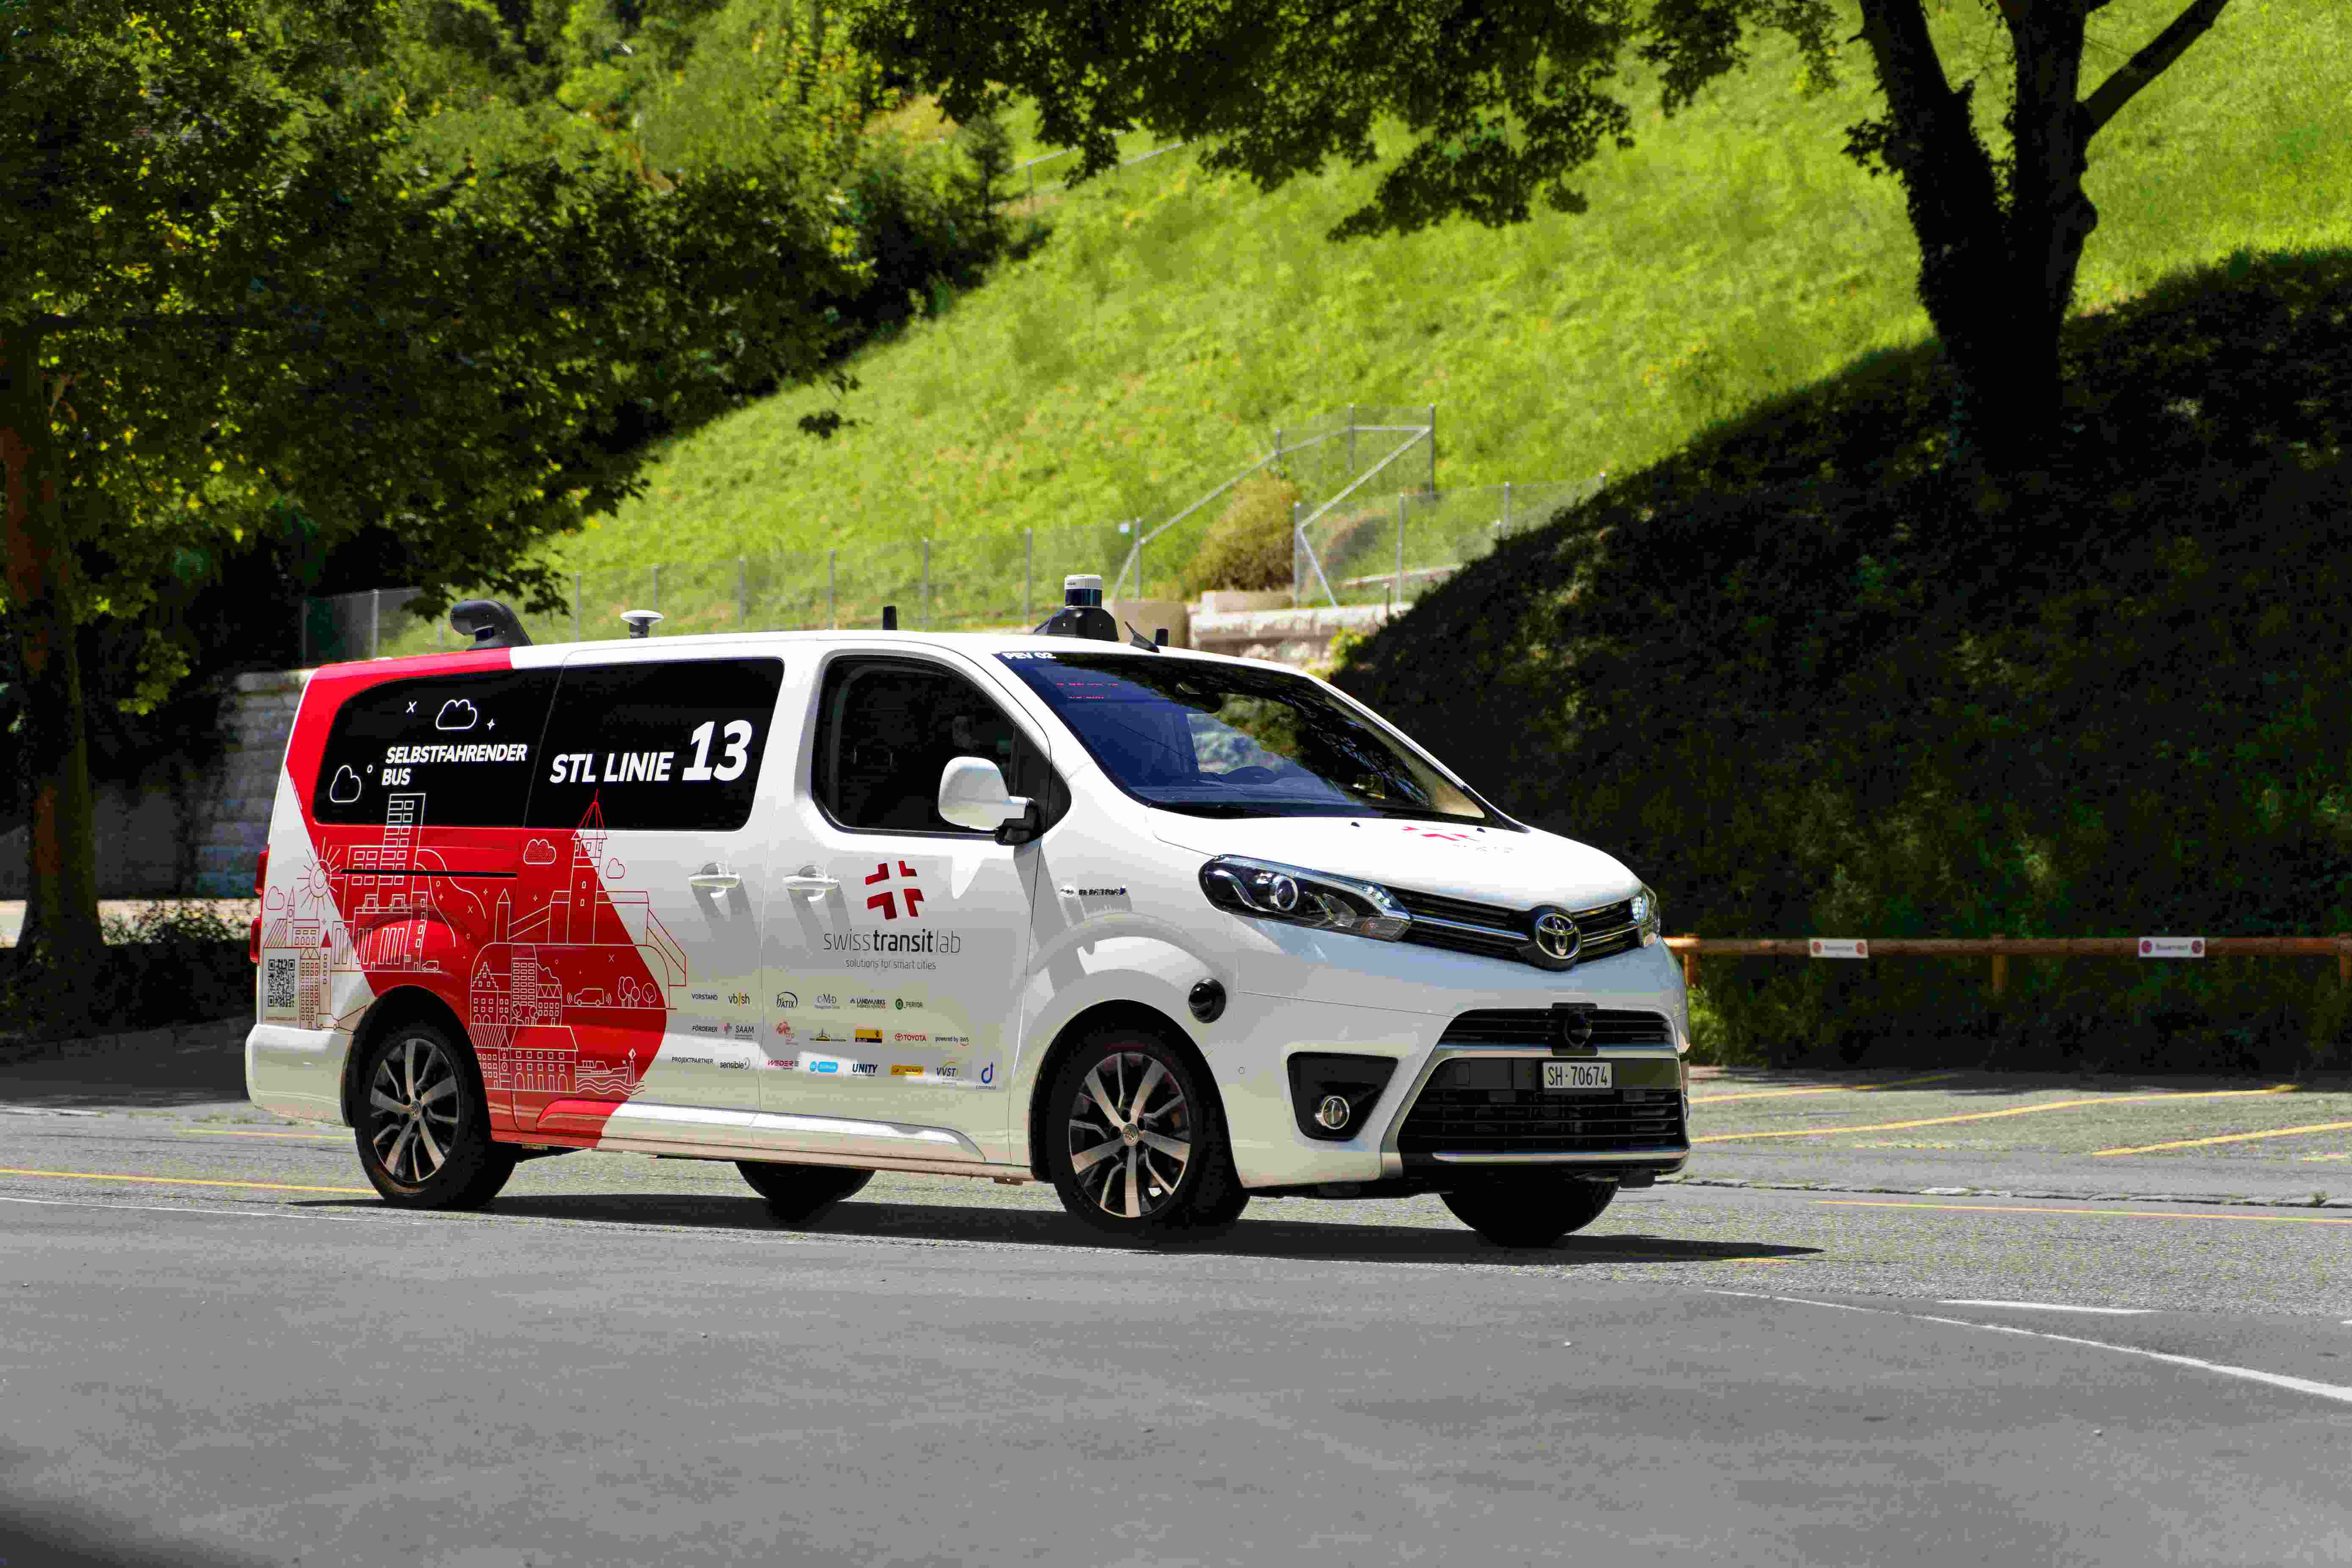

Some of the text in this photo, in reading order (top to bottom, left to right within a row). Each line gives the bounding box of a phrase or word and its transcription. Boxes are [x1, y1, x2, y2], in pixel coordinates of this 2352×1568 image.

[385, 744, 528, 763] SELBSTFAHRENDER
[549, 719, 752, 783] STL LINIE 13
[381, 768, 411, 785] BUS
[846, 959, 937, 970] solutions for smart cities
[692, 1024, 718, 1032] FÖRDERER
[735, 1025, 754, 1033] SAAM
[852, 1064, 878, 1073] UNITY
[936, 1067, 956, 1077] VVST
